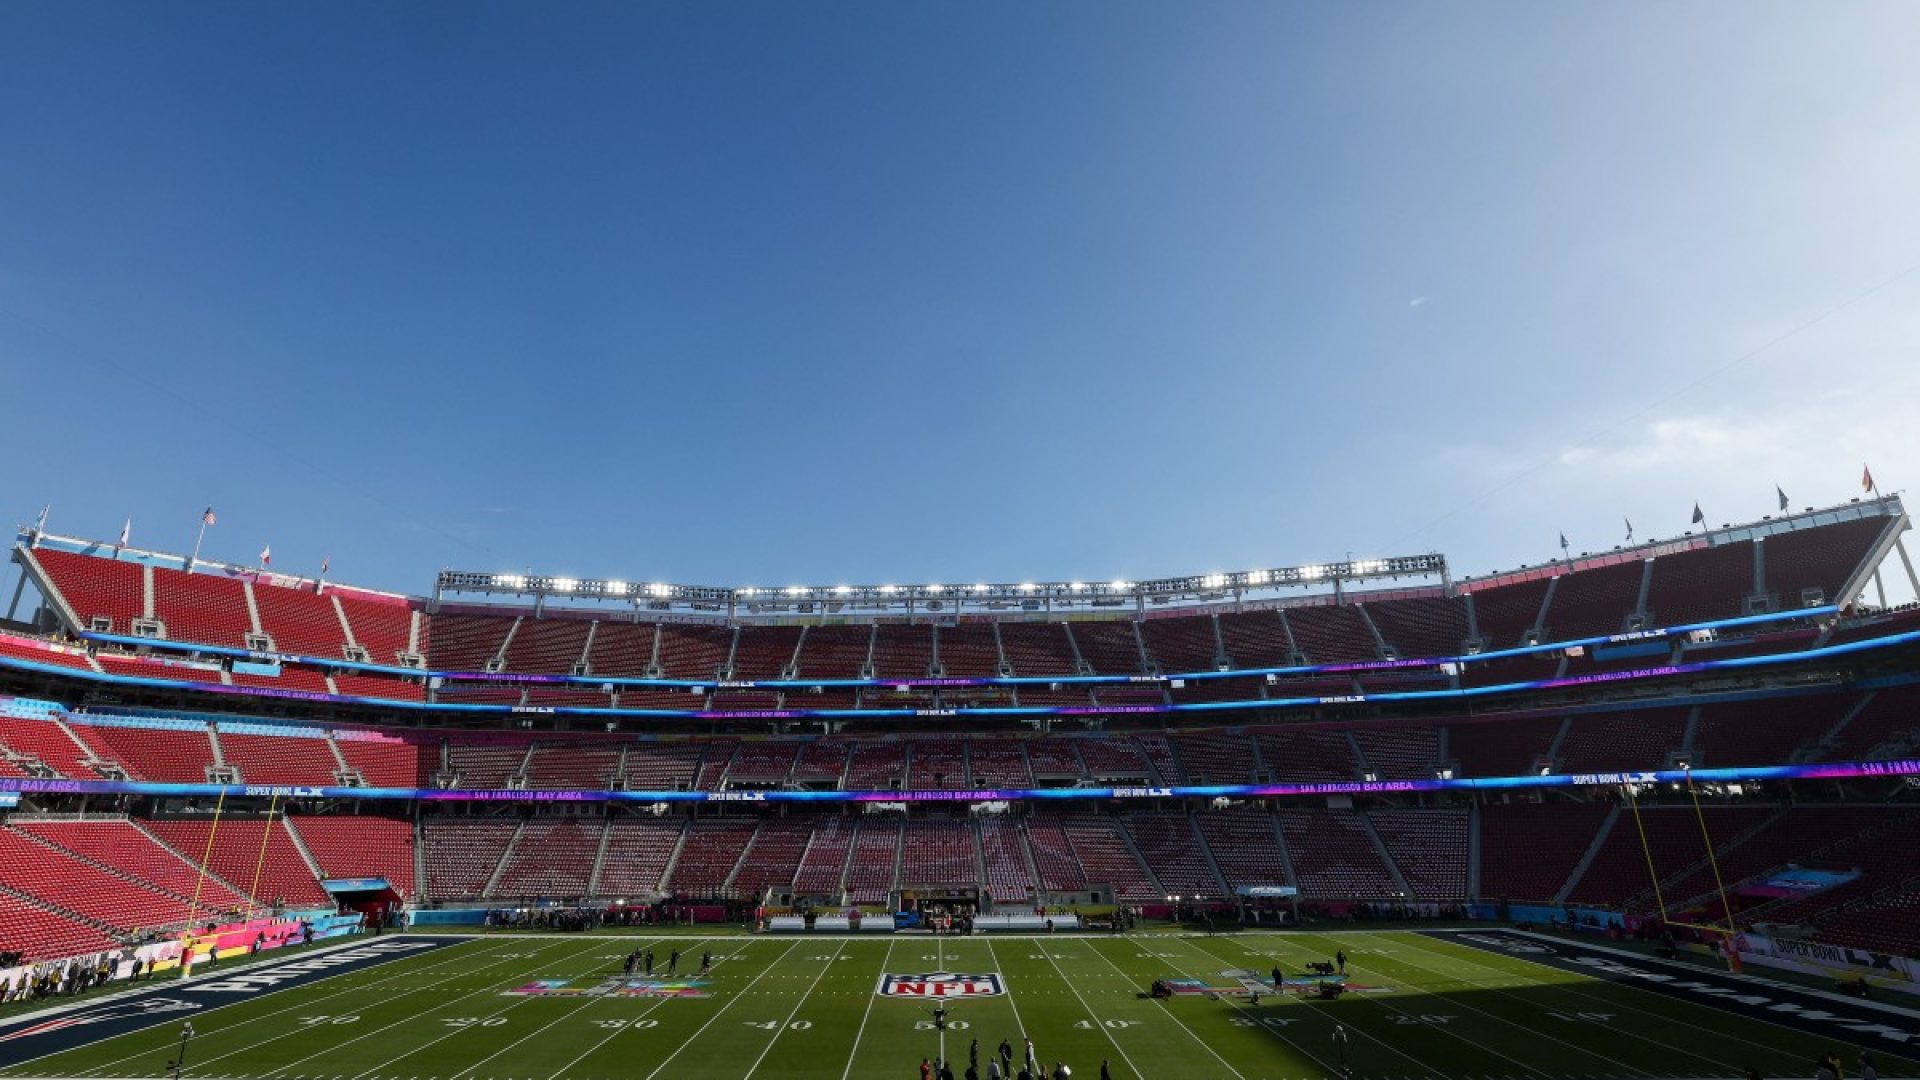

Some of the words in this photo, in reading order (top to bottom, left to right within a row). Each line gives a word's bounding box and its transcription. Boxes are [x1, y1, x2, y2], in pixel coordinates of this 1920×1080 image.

[1862, 762, 1884, 775] SAN
[1887, 760, 1920, 774] FRAN
[1572, 775, 1597, 785] SUPER
[1598, 774, 1622, 783] BOWL
[20, 780, 47, 791] BAY
[47, 781, 81, 791] AREA
[245, 786, 270, 796] SUPER
[271, 787, 293, 796] BOWL
[1363, 783, 1383, 791] BAY
[1384, 782, 1413, 790] AREA
[1776, 938, 1811, 957] SUPER
[1812, 944, 1845, 963] BOWL
[1845, 949, 1898, 972] LX
[895, 982, 991, 996] NFL
